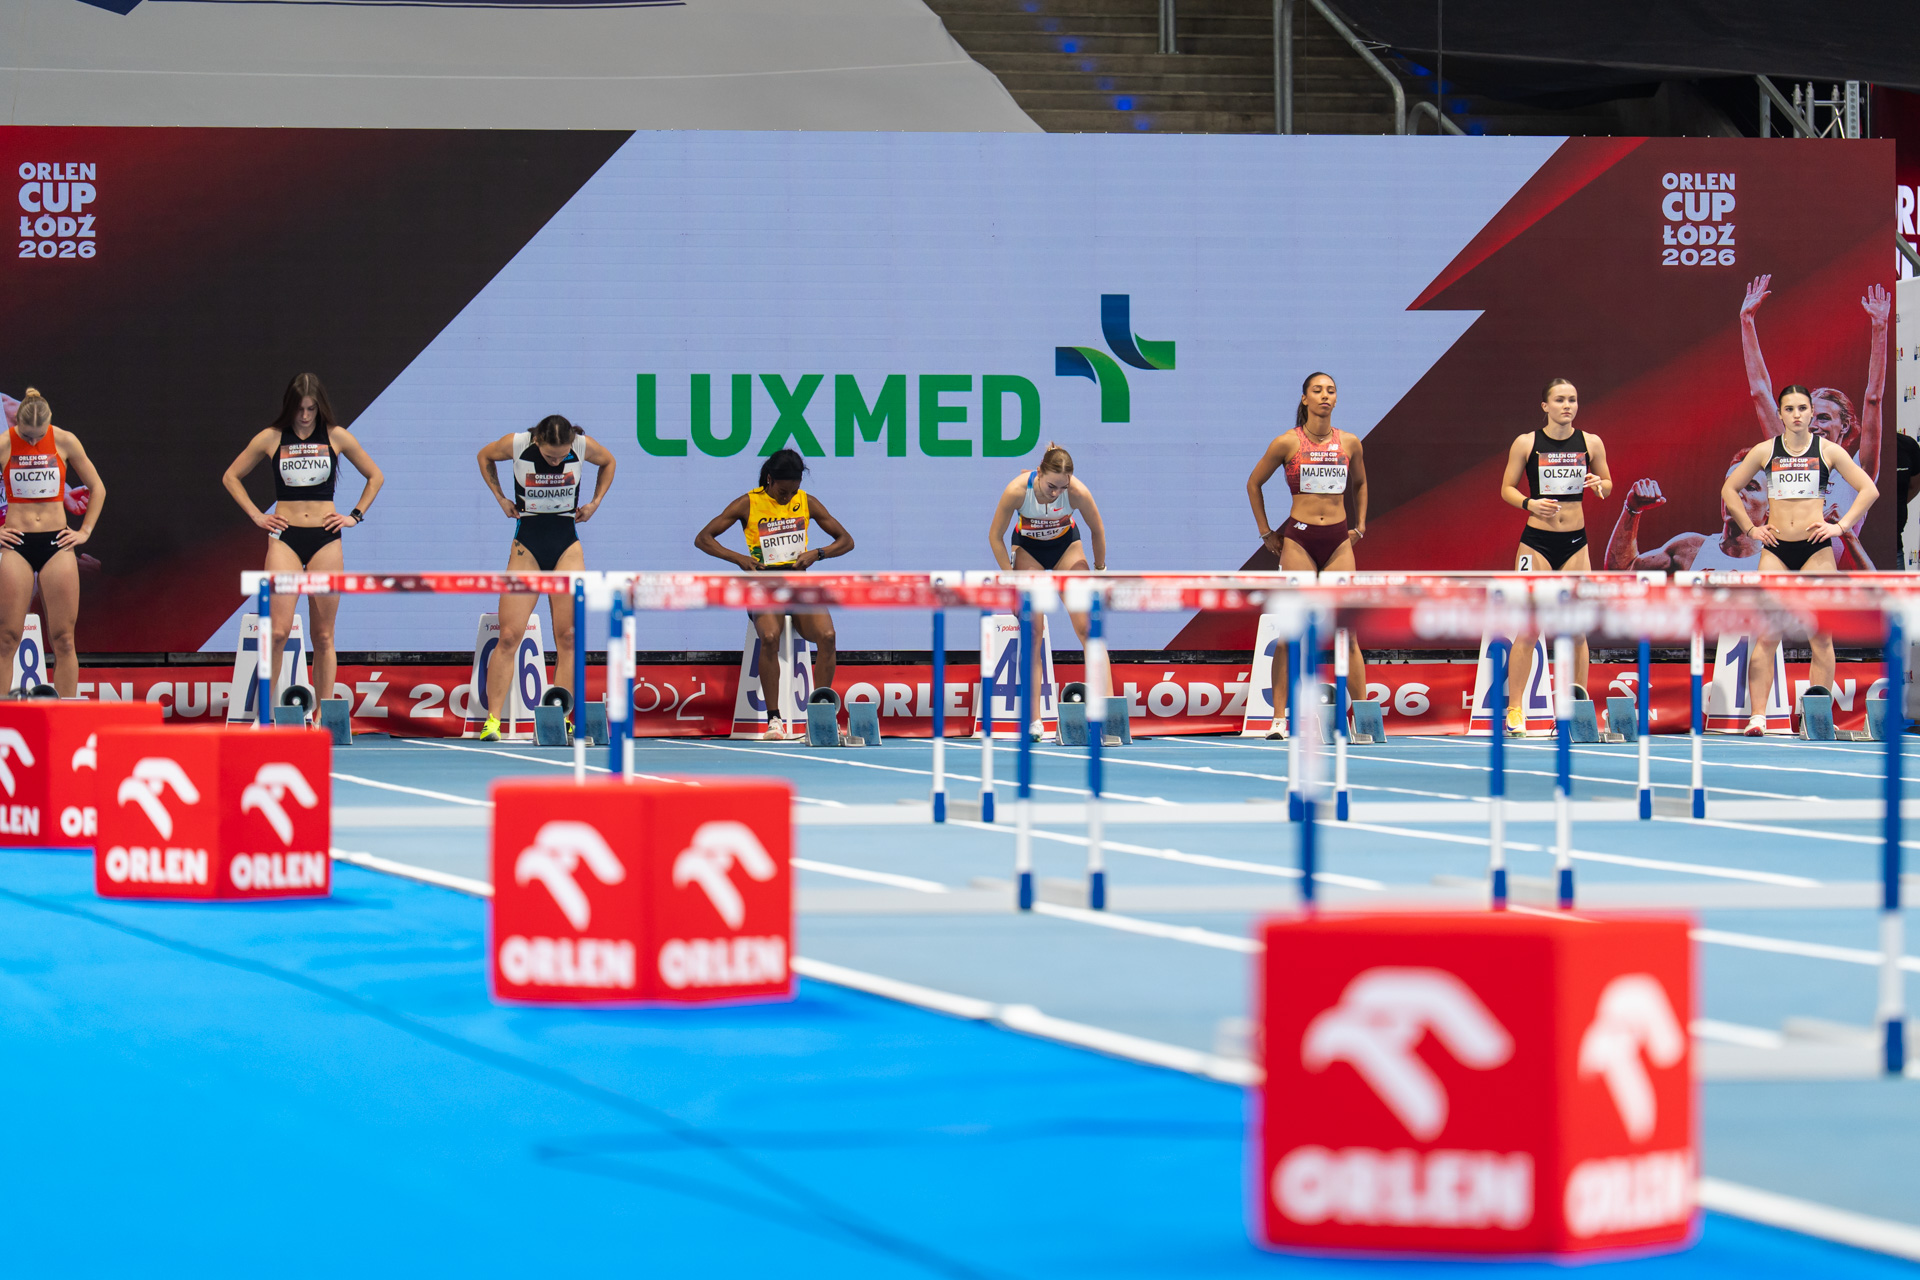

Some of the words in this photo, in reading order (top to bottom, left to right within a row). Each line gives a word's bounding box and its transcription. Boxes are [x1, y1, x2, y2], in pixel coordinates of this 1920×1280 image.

[18, 162, 96, 181] ORLEN
[1662, 172, 1736, 190] ORLEN
[18, 182, 96, 213] CUP
[1662, 192, 1736, 222] CUP
[18, 213, 96, 238] ŁÓDŹ
[1663, 223, 1736, 246] ŁÓDŹ
[18, 240, 96, 259] 2026
[1662, 249, 1736, 266] 2026
[637, 373, 1041, 457] LUXMED
[14, 471, 55, 481] OLCZYK
[282, 458, 329, 471] BROŻYNA
[1302, 467, 1346, 478] MAJEWSKA
[1543, 469, 1582, 478] OLSZAK
[1779, 473, 1811, 483] ROJEK
[527, 488, 573, 498] GLOJNARIC
[763, 533, 804, 548] BRITTON
[1520, 556, 1529, 571] 2
[19, 638, 42, 696] 8
[519, 637, 542, 711] 6
[794, 638, 810, 712] 5
[991, 638, 1021, 711] 4
[1529, 639, 1548, 709] 2
[1726, 635, 1749, 708] 1
[146, 681, 232, 718] CUP
[409, 683, 471, 719] 20
[844, 682, 981, 717] ORLE
[1123, 672, 1250, 718] ŁÓDŹ
[1365, 682, 1431, 717] 26
[0, 804, 40, 836] LEN
[105, 846, 208, 884] ORLEN
[230, 852, 325, 890] ORLEN
[500, 935, 637, 990] ORLEN
[659, 935, 788, 990] ORLEN
